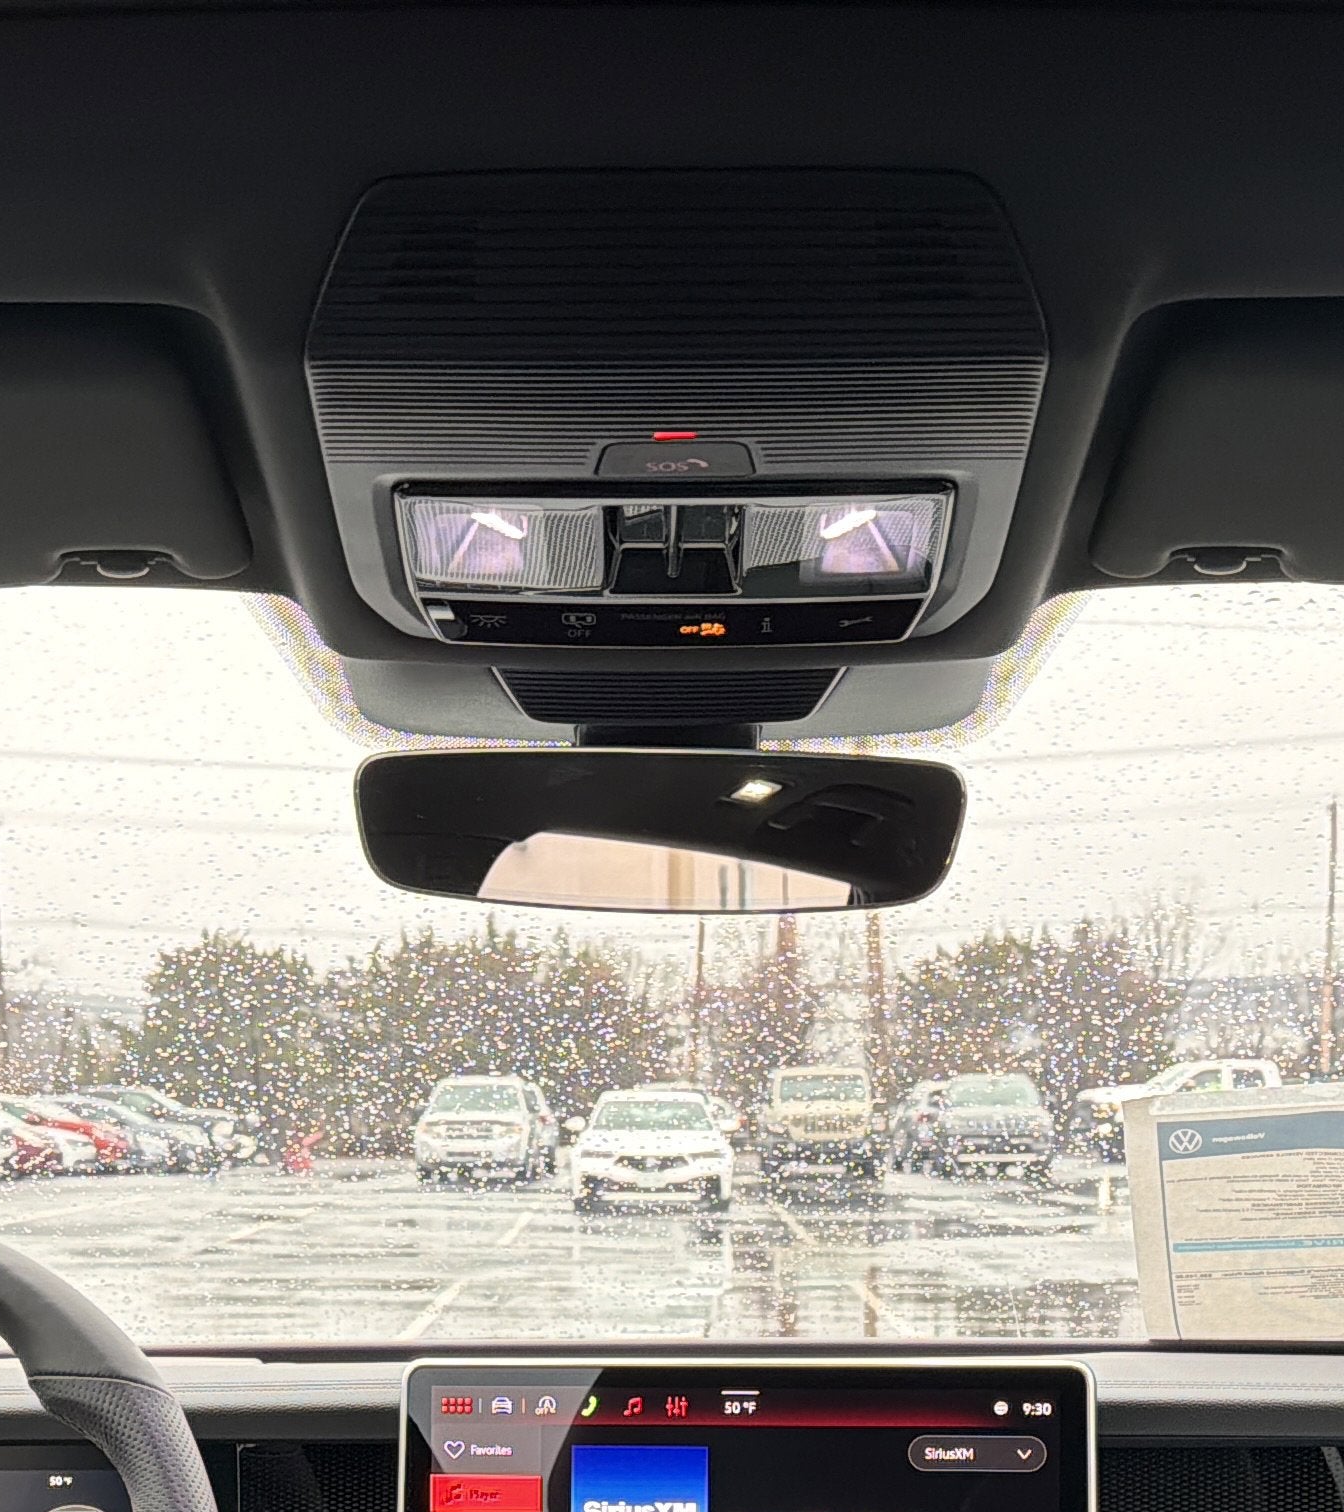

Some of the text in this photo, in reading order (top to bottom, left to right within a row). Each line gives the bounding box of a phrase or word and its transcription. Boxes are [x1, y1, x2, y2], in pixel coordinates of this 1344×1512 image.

[646, 463, 689, 471] SOS
[567, 630, 591, 638] OFF
[680, 626, 699, 634] OFF
[724, 1401, 740, 1414] 50
[1022, 1403, 1052, 1416] 9:30
[470, 1444, 512, 1456] Favorites
[924, 1448, 974, 1460] SiriusXM
[49, 1476, 62, 1486] 50
[469, 1489, 500, 1500] Player
